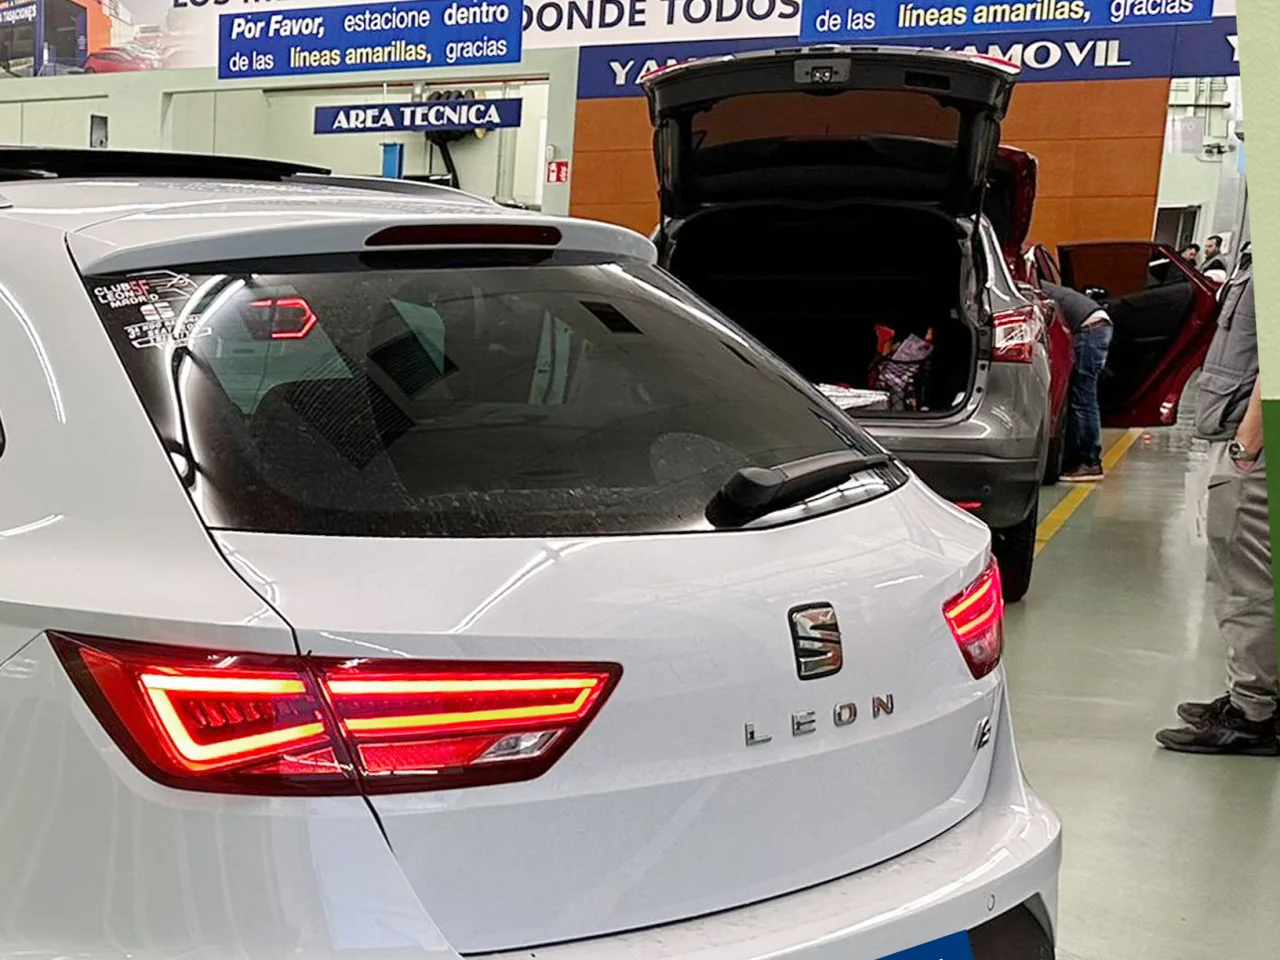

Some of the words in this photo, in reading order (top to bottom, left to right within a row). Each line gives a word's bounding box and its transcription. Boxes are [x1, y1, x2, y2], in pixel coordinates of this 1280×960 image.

[231, 18, 265, 40] Por
[268, 15, 325, 38] Favor,
[344, 8, 430, 32] estacione
[444, 3, 509, 26] dentro
[660, 0, 800, 25] TODOS
[815, 10, 842, 32] de
[847, 8, 876, 30] las
[898, 4, 967, 28] líneas
[972, 0, 1091, 23] amarillas,
[1111, 0, 1194, 22] gracias
[229, 52, 250, 73] de
[253, 51, 274, 70] las
[290, 46, 341, 69] líneas
[345, 41, 431, 65] amarillas,
[446, 37, 507, 64] gracias
[333, 108, 396, 130] AREA
[400, 104, 501, 127] TECNICA
[94, 282, 131, 296] CLUB
[744, 693, 895, 747] LEON
